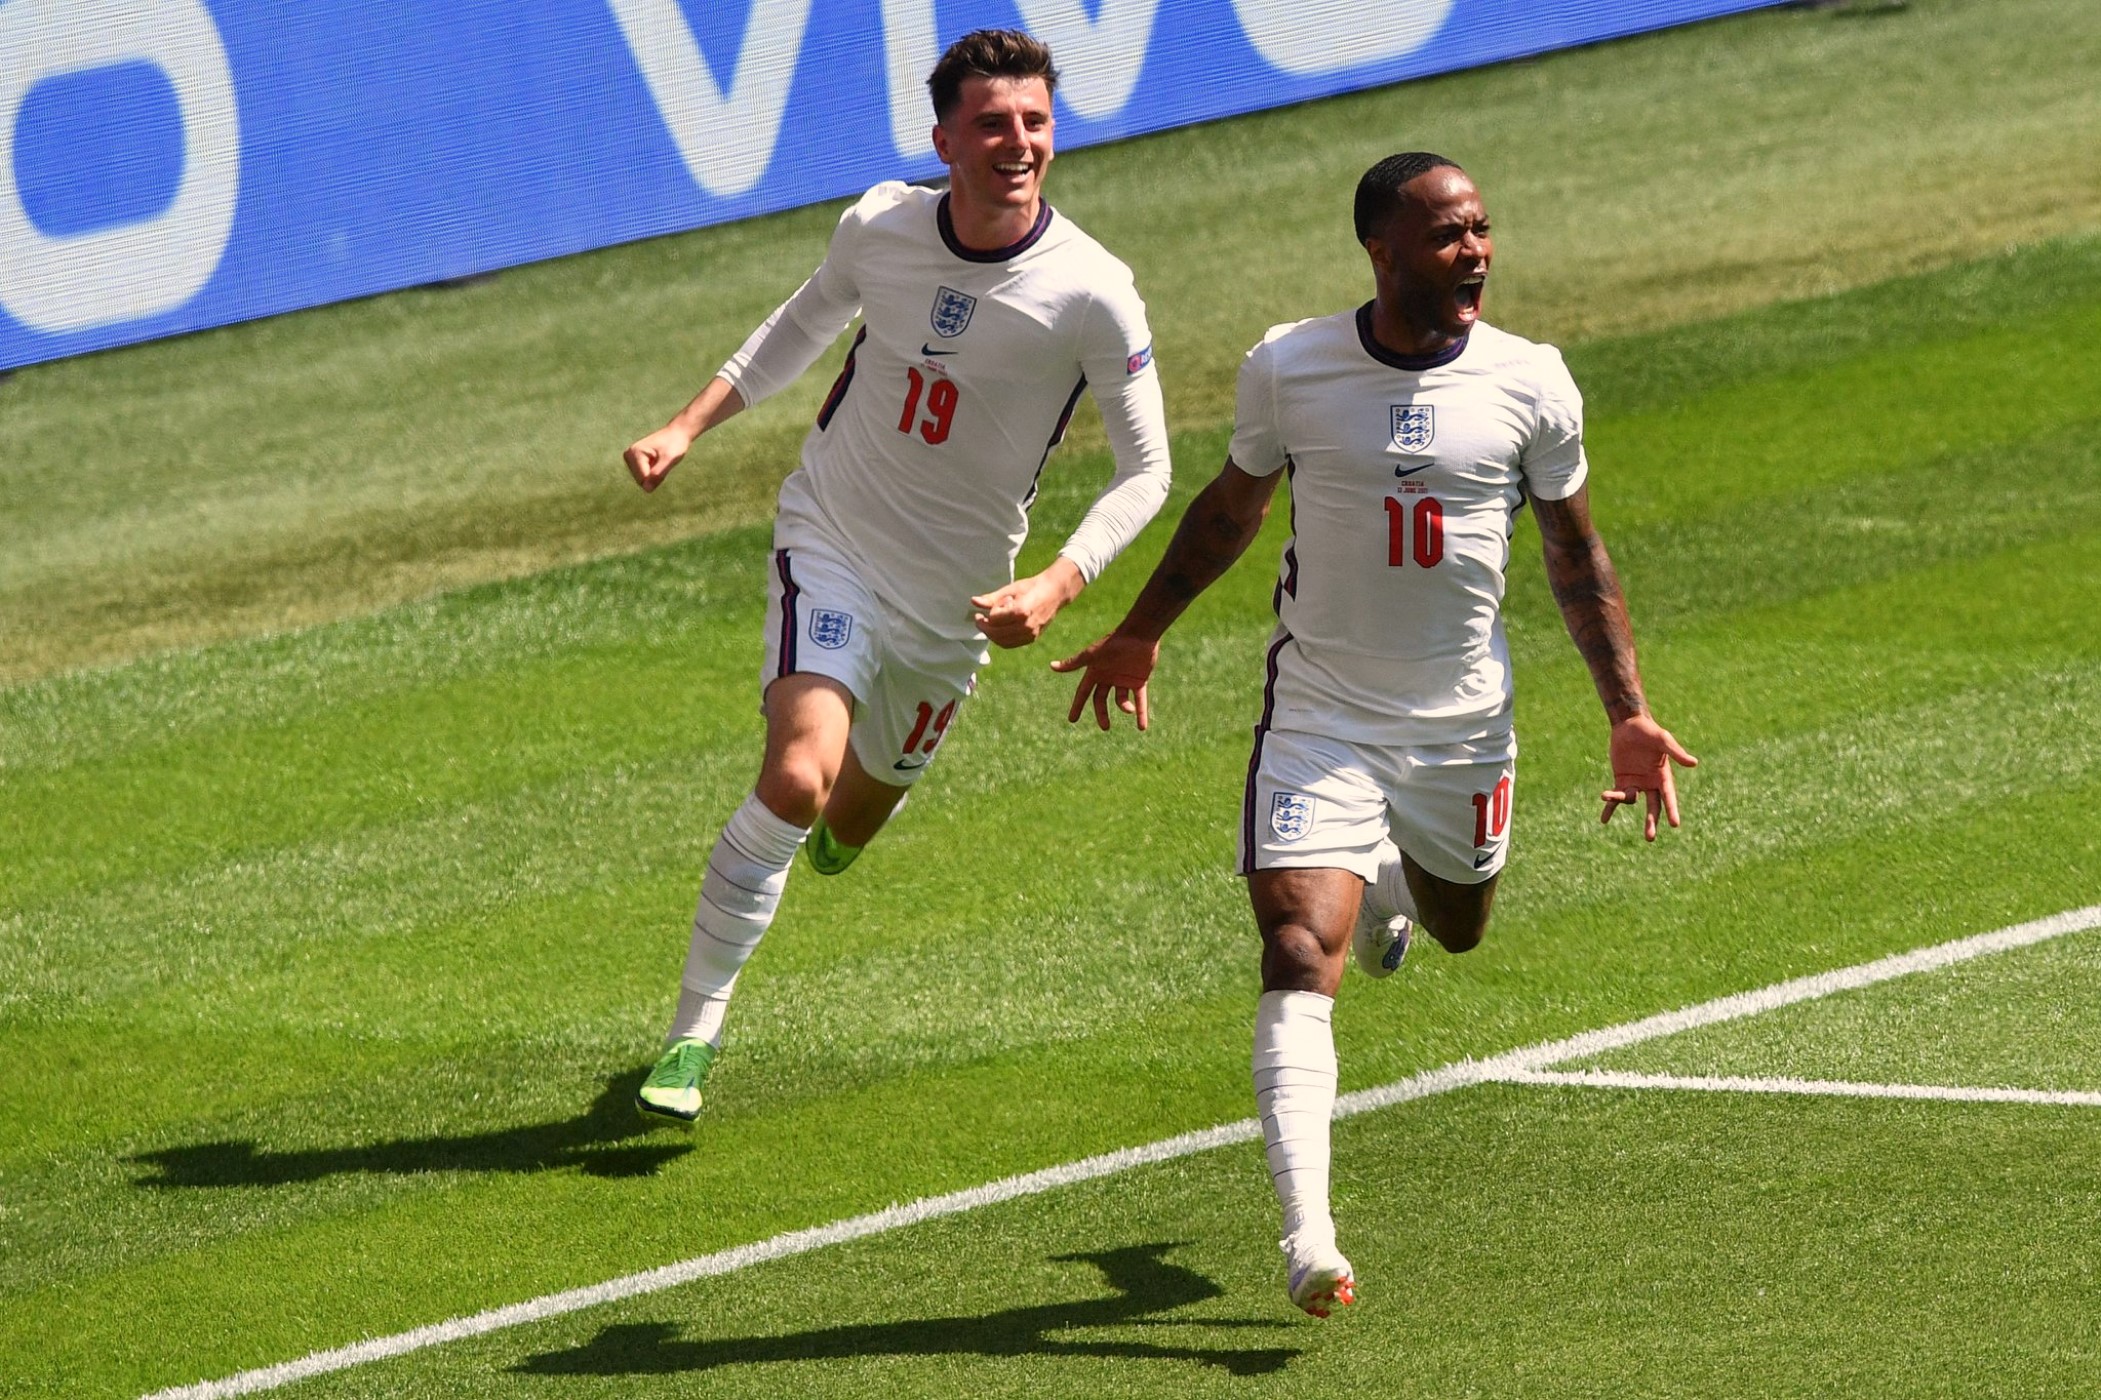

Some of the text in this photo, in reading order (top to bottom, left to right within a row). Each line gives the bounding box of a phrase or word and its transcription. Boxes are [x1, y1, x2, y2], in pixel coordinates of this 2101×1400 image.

[897, 366, 960, 445] 19
[1384, 496, 1444, 568] 10
[1471, 776, 1510, 849] 10
